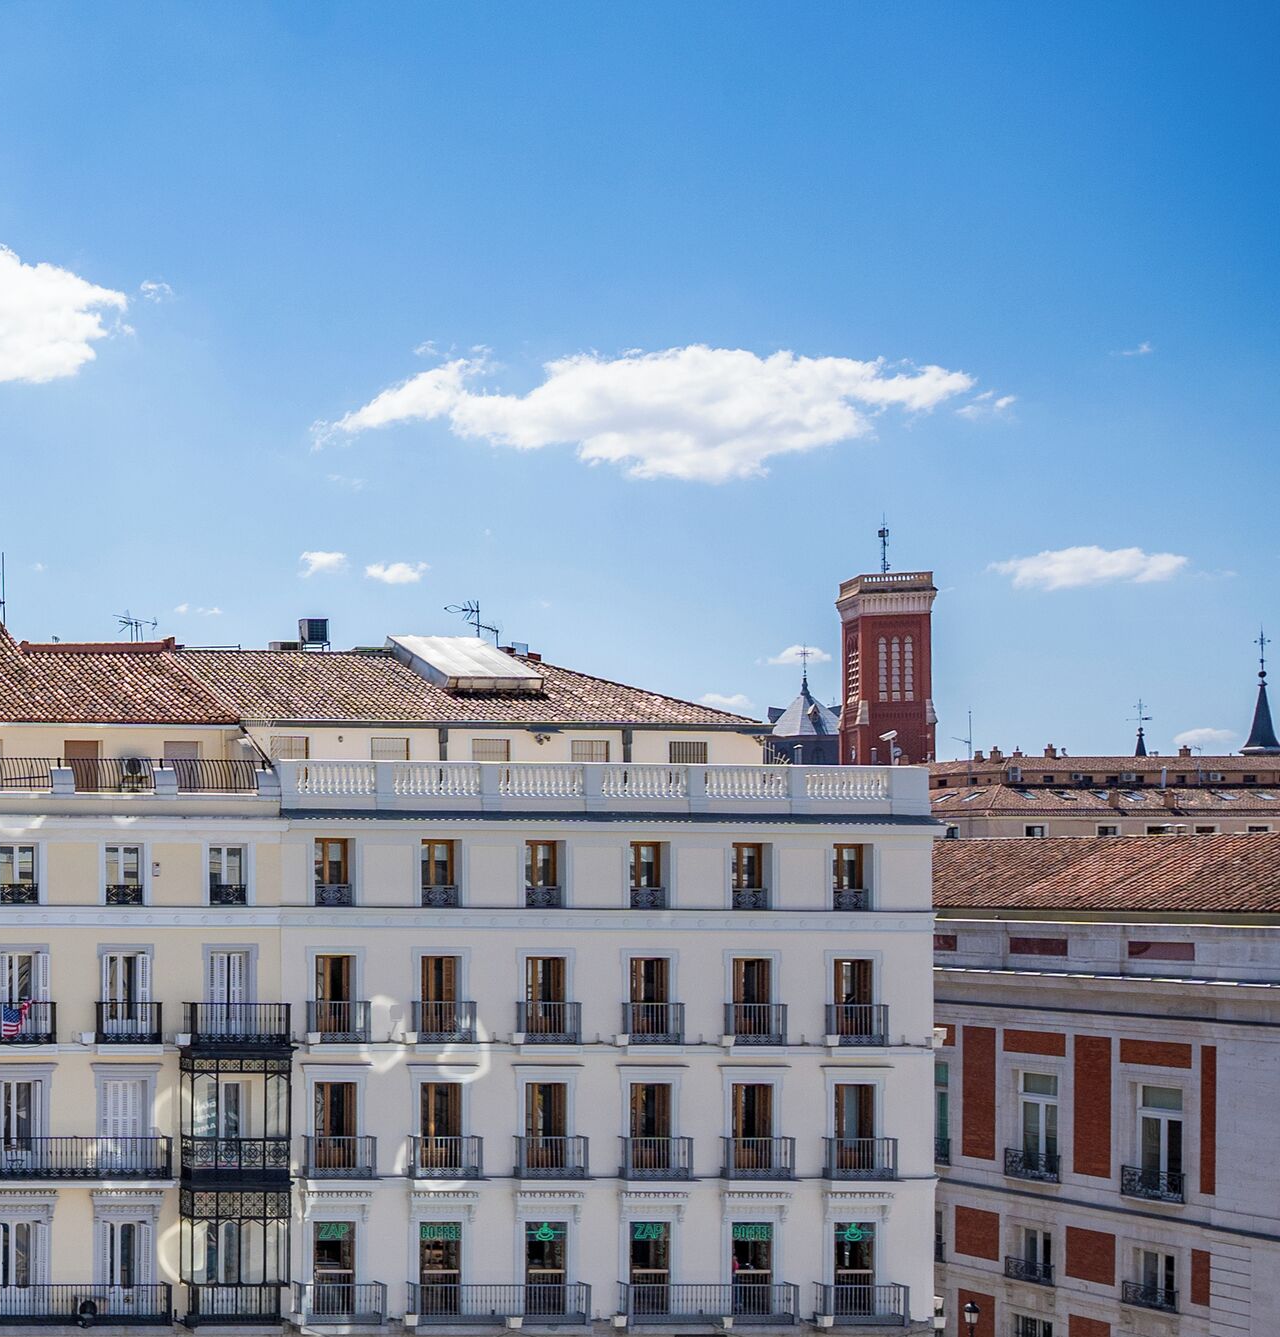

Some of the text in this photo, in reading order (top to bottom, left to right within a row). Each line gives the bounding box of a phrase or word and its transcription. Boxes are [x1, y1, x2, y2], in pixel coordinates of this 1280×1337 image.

[319, 1223, 349, 1239] ZAP
[420, 1224, 461, 1240] COFFEE
[634, 1223, 664, 1240] ZAP
[732, 1225, 771, 1241] COFFEE
